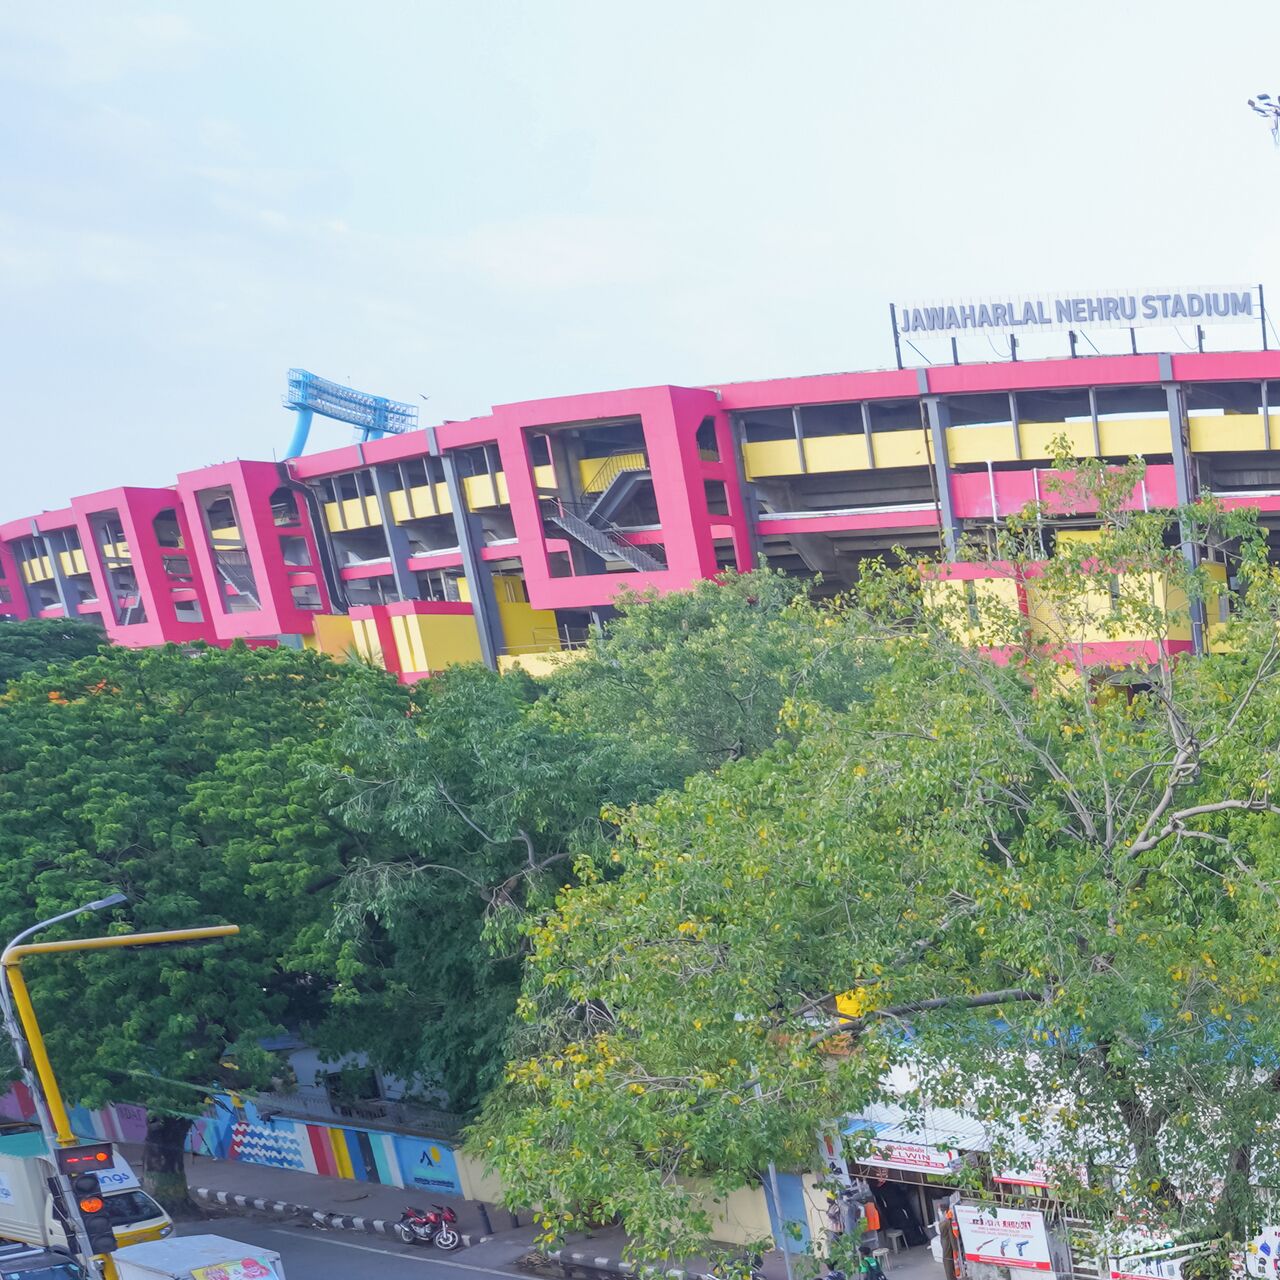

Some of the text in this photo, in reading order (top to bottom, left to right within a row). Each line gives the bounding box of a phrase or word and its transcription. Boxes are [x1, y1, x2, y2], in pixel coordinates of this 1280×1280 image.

[900, 291, 1253, 334] JAWAHARLAL NEHRU STADIUM
